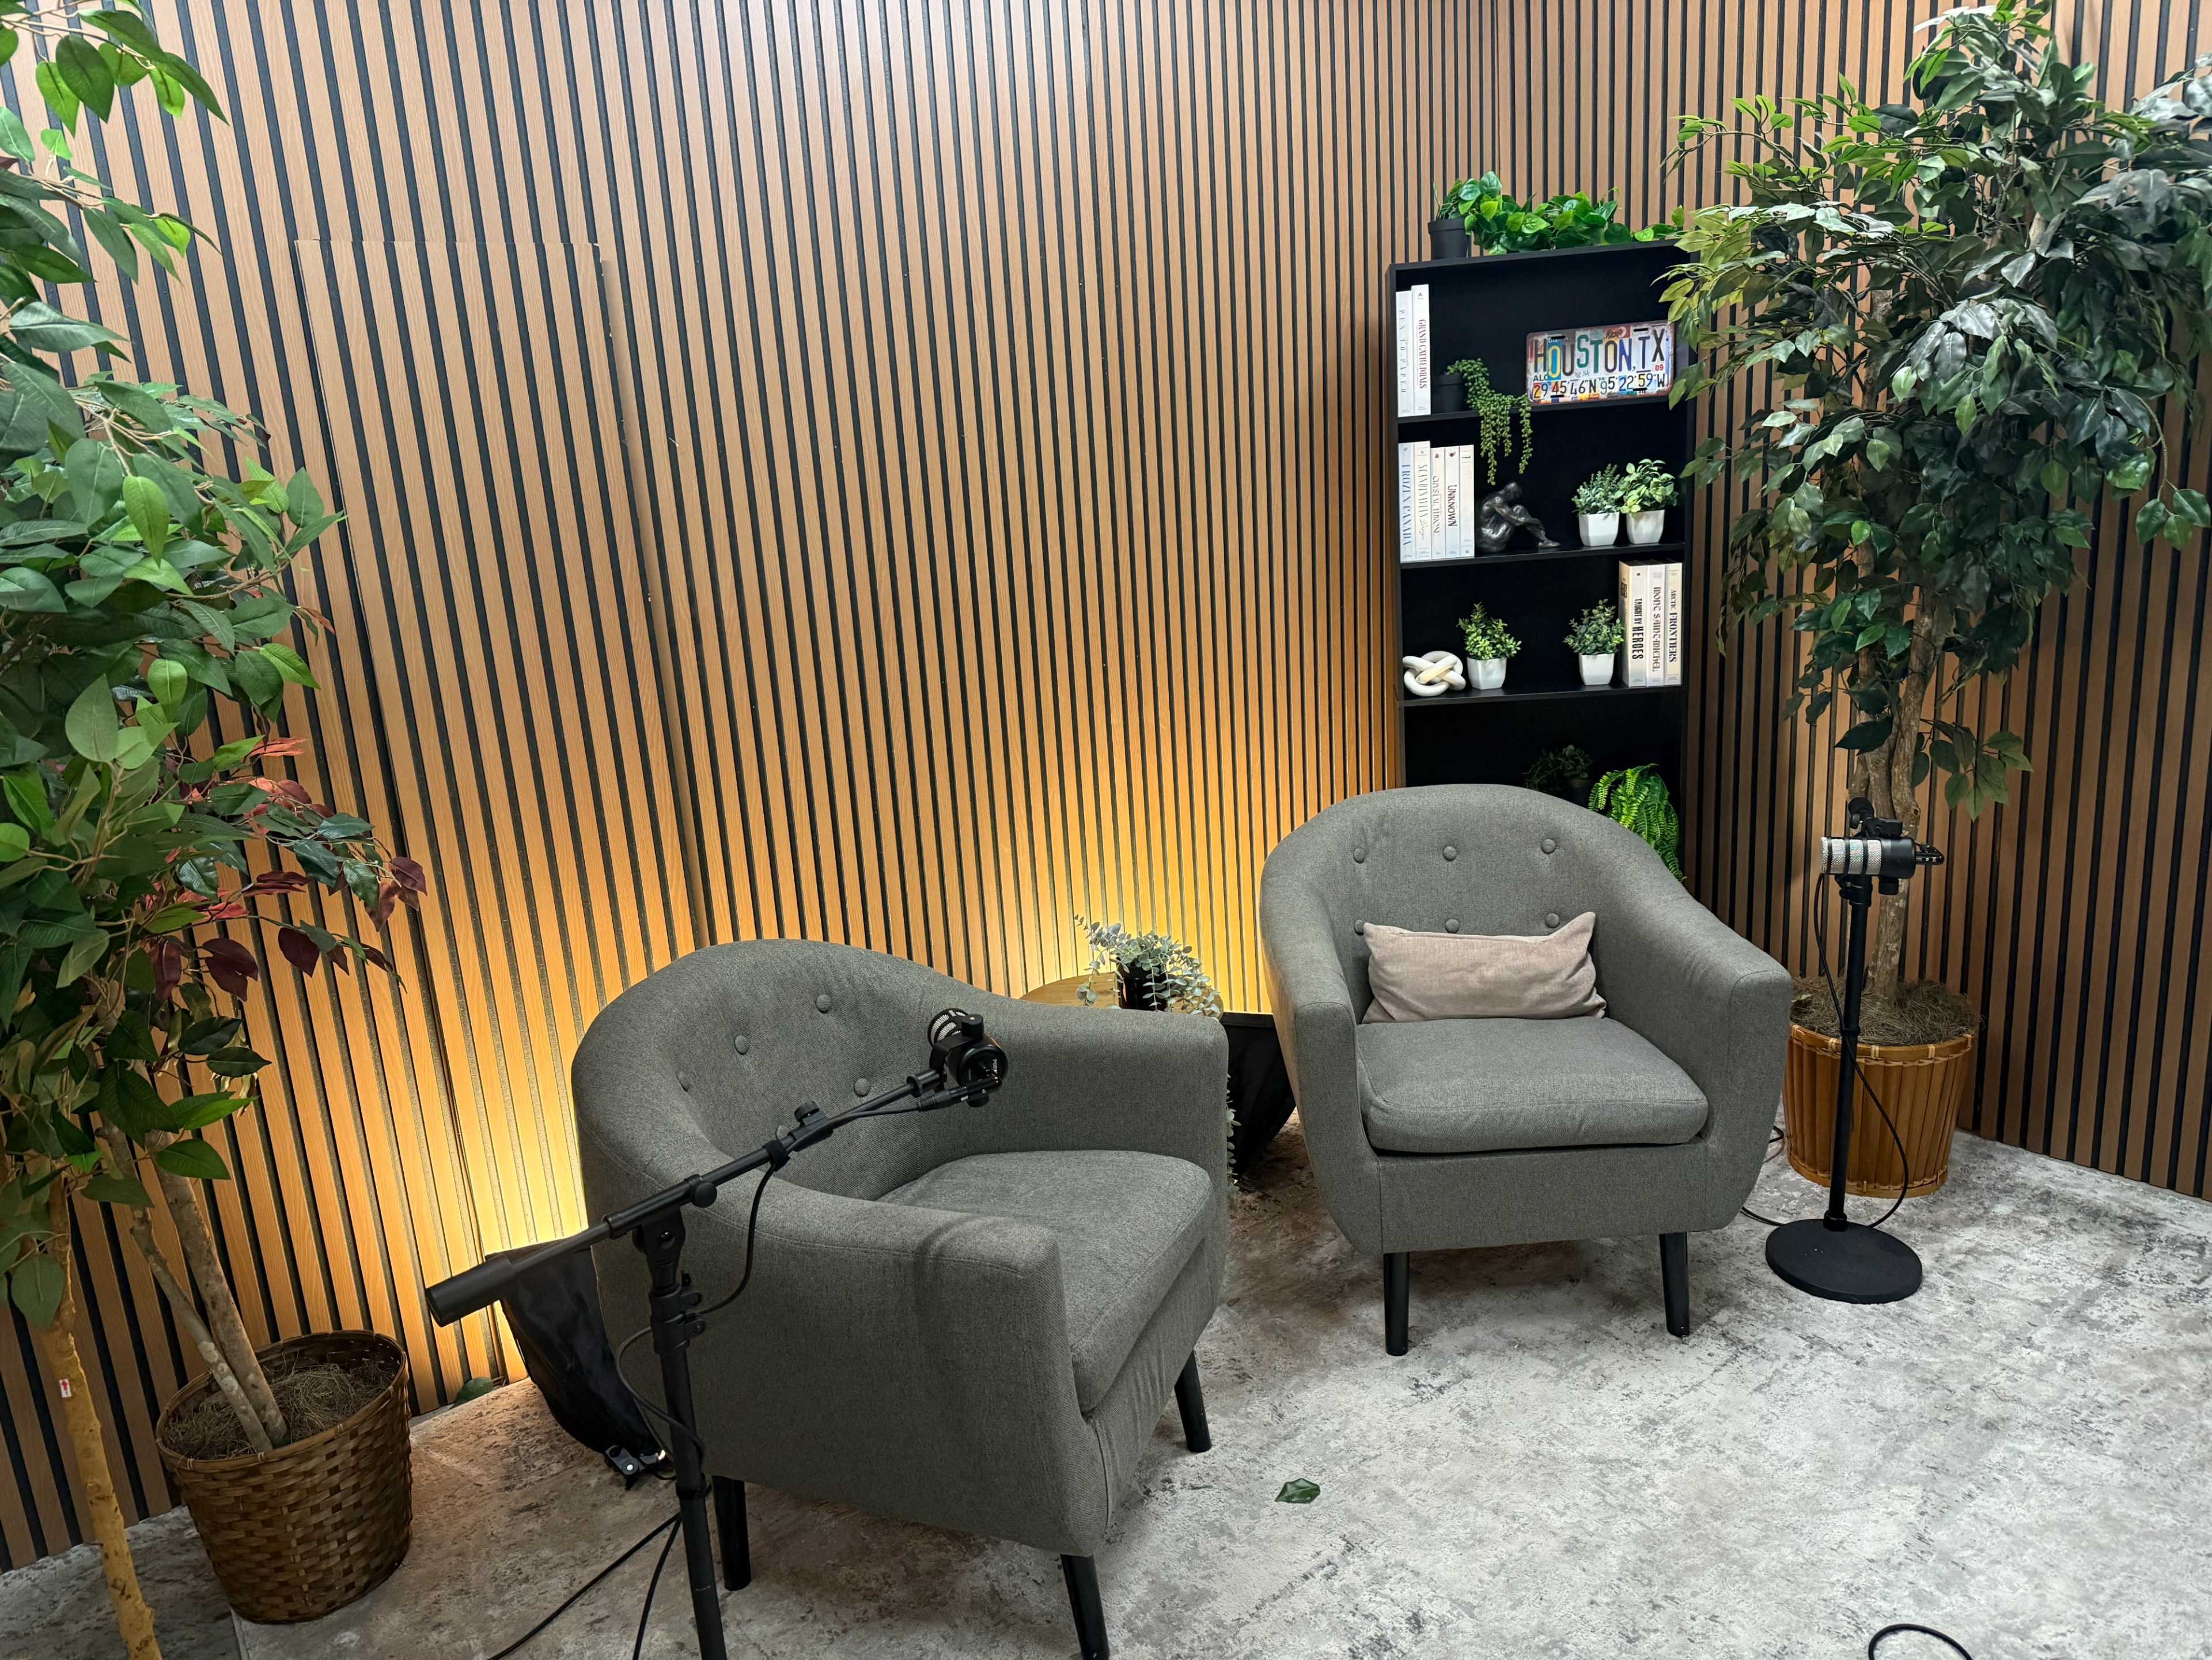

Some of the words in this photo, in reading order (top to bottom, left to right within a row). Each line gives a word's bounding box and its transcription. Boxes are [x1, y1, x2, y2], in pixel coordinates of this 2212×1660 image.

[1419, 319, 1427, 343] GRAND
[1419, 345, 1427, 389] CATHEDRALS
[1402, 464, 1411, 501] FROZEN
[1418, 464, 1427, 518] SCANDINAVIAN
[1433, 507, 1441, 535] THRONE
[1448, 485, 1457, 527] UNKNOWN
[1403, 506, 1411, 546] CANADA
[1634, 599, 1642, 617] TAUGHT
[1653, 587, 1661, 611] MONT
[1632, 626, 1644, 659] HEROES
[1653, 614, 1661, 672] SAINT-MICHEL
[1668, 612, 1677, 663] FRONTIERS
